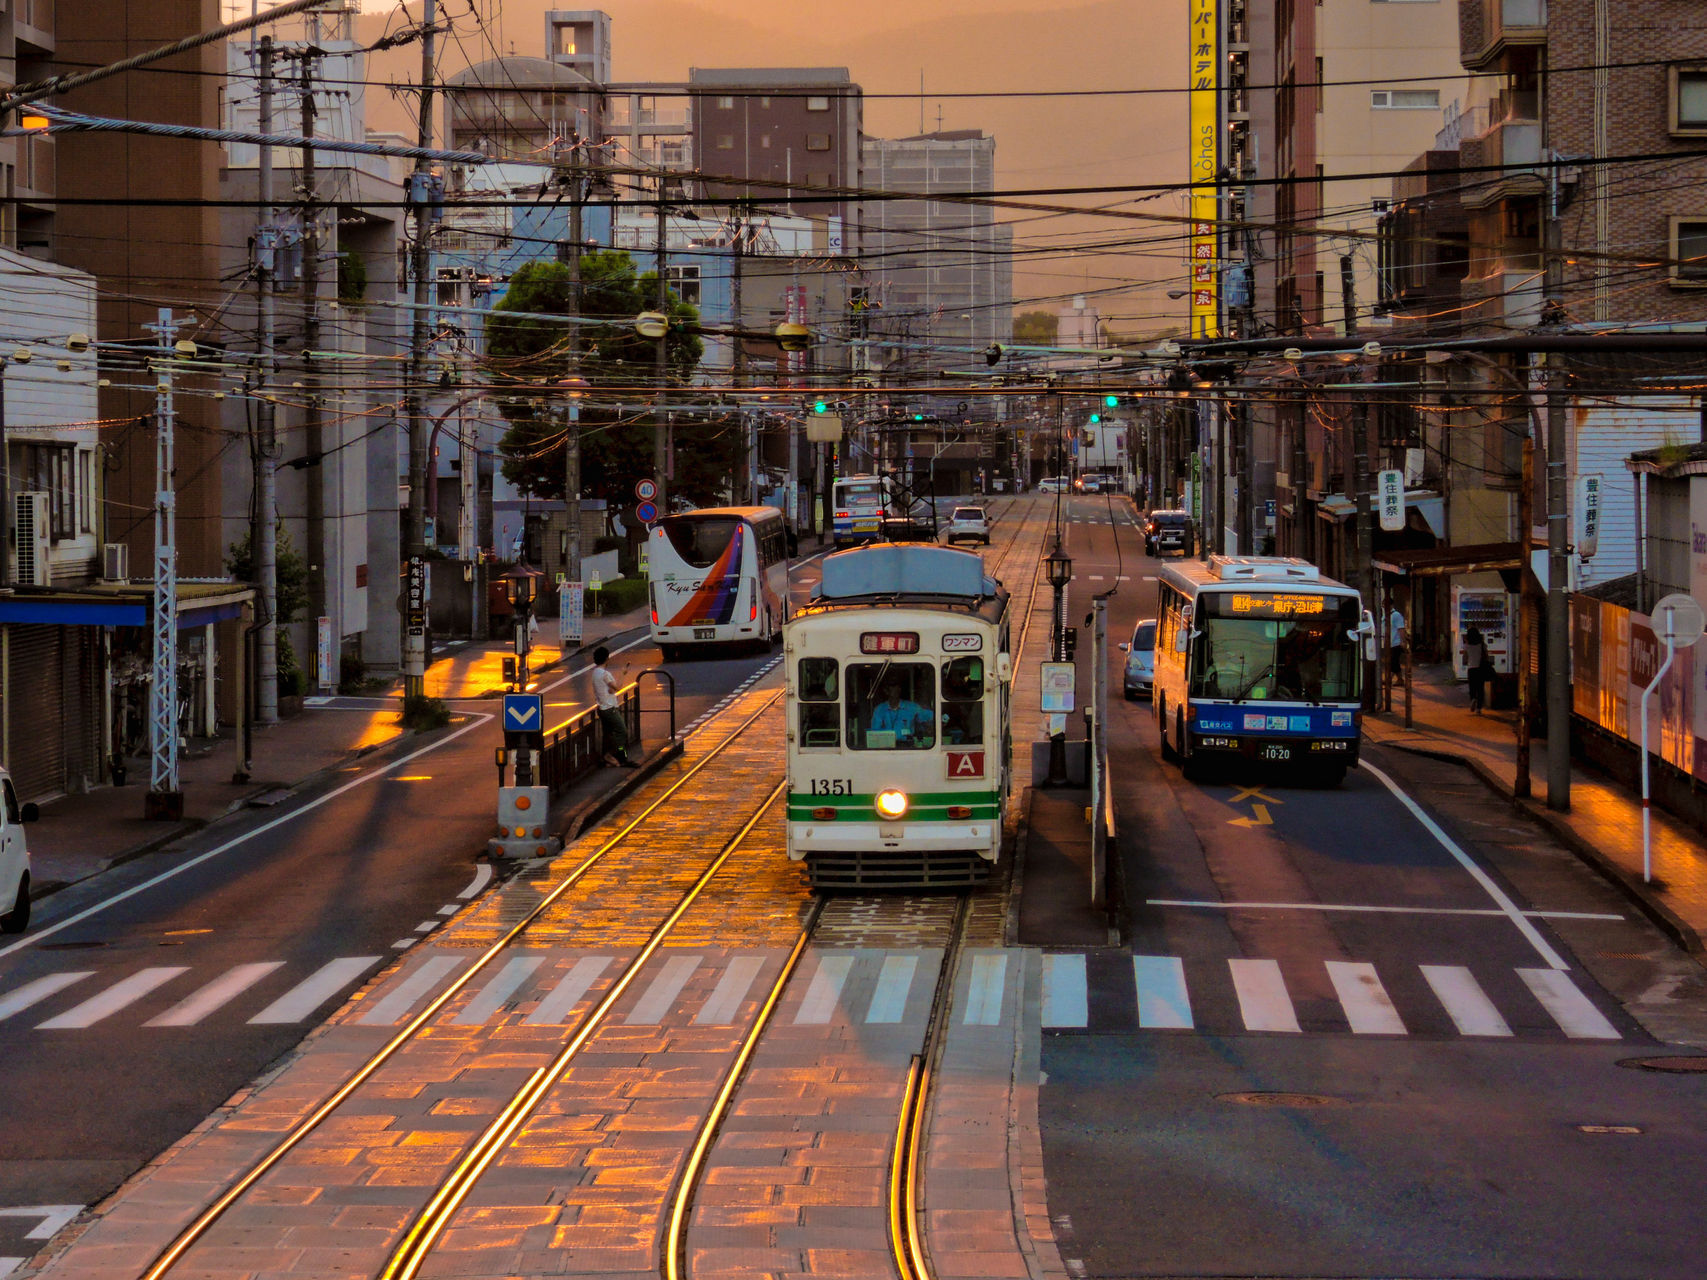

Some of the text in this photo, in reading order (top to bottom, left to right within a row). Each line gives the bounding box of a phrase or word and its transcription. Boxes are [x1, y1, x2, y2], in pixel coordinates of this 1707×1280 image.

[640, 485, 653, 496] 40
[1585, 478, 1598, 538] 豊住葬祭
[862, 635, 914, 652] 健軍町
[944, 637, 979, 647] ワンマン
[956, 755, 976, 774] A
[810, 779, 854, 797] 1351
